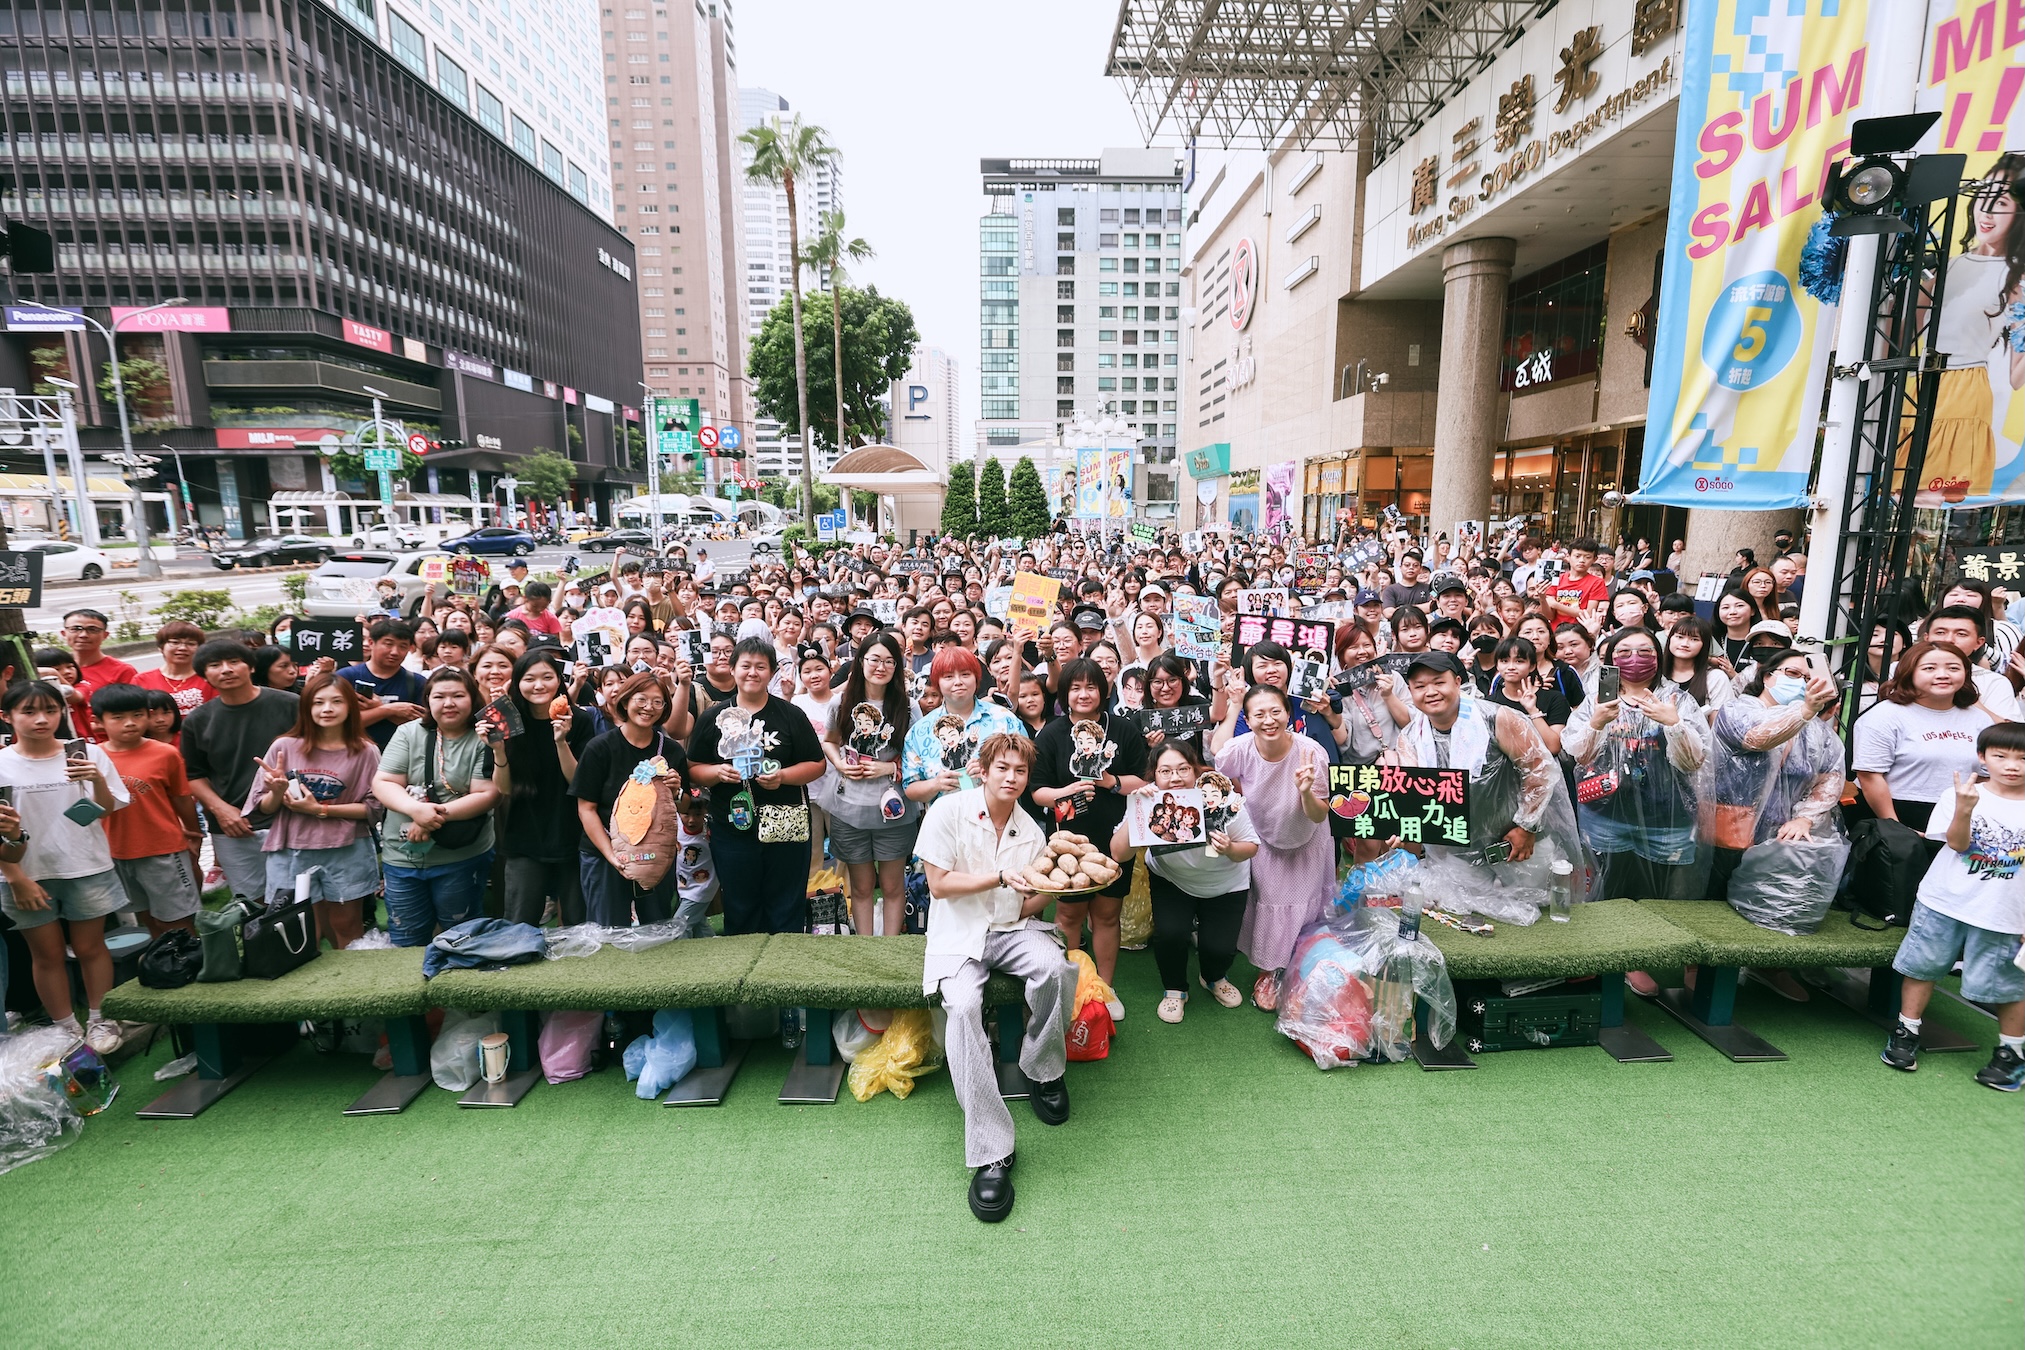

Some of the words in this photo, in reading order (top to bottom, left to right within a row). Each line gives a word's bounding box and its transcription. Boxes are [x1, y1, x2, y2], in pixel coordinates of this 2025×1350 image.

[1695, 47, 1868, 179] SUM
[1407, 214, 1443, 249] Kuang
[1447, 196, 1475, 223] San
[1479, 140, 1542, 202] SOGO
[1549, 55, 1671, 158] Department
[12, 310, 74, 323] Panasonic
[137, 313, 180, 327] POYA
[352, 325, 383, 342] TASTY
[1733, 306, 1772, 362] 5
[1515, 350, 1553, 388] 瓦城
[1729, 367, 1752, 386] 折起
[909, 386, 928, 411] P
[248, 432, 275, 444] MUJI
[1108, 450, 1130, 466] MER
[1080, 461, 1101, 477] SUM
[1710, 482, 1734, 490] SOGO
[1959, 552, 2025, 582] 蕭景
[1556, 589, 1583, 597] EGGY
[297, 628, 354, 651] 阿弟
[1238, 616, 1328, 650] 蕭景鴻
[1150, 707, 1204, 728] 蕭景鴻
[1922, 731, 1937, 741] LOS
[1939, 730, 1973, 742] ANGELES
[1329, 764, 1464, 804] 阿弟放心飛
[1980, 870, 2015, 881] ZERO
